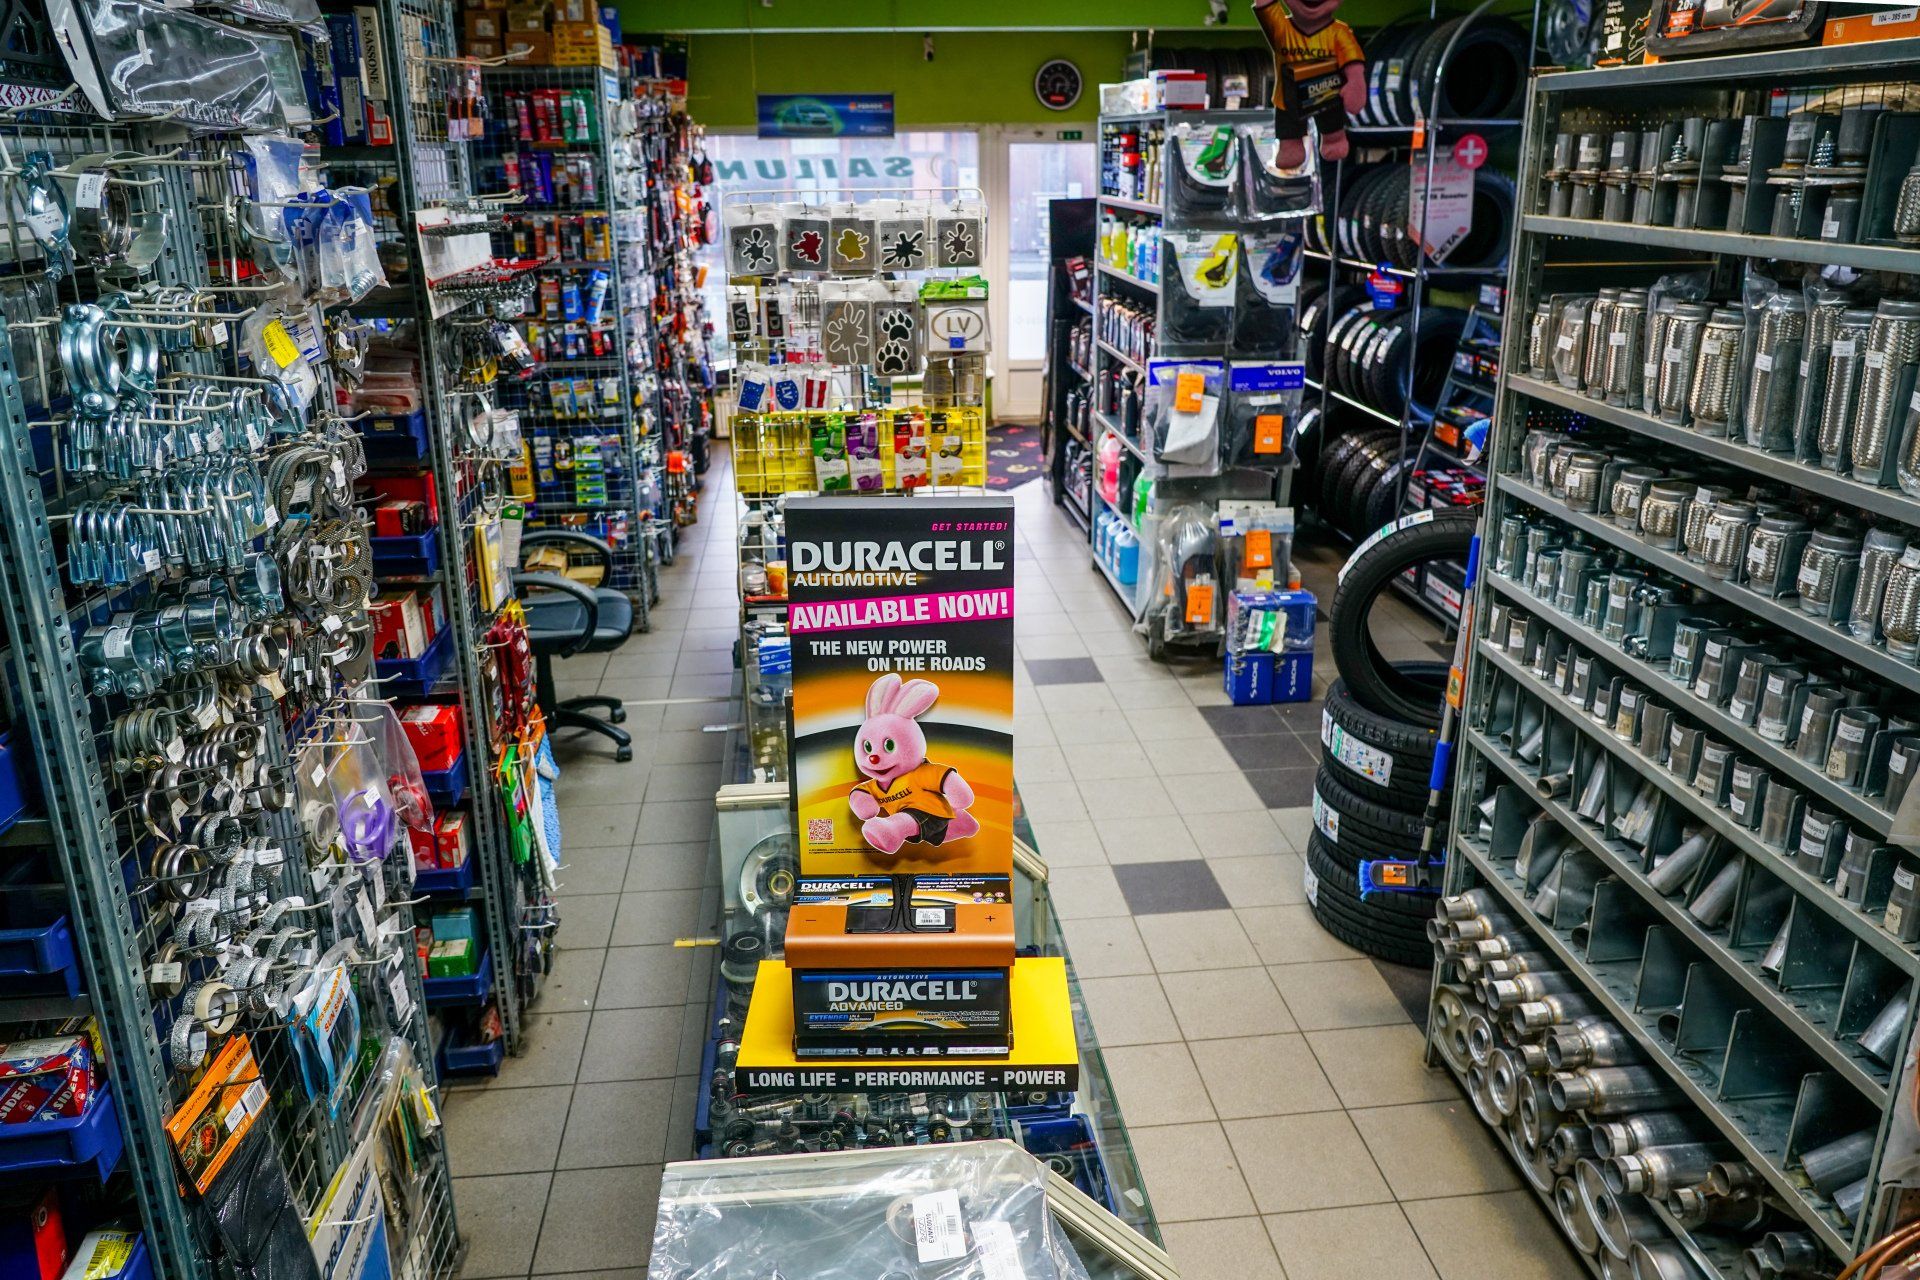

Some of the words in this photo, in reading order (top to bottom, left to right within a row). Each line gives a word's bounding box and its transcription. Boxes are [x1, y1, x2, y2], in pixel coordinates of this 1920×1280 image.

[346, 34, 355, 63] SACHS
[364, 29, 380, 84] SASSONE
[734, 305, 748, 329] V6
[947, 316, 971, 333] LV
[1267, 368, 1301, 376] VOLVO
[781, 386, 794, 400] LV
[931, 523, 951, 531] GET
[956, 522, 1008, 531] STARTED!
[793, 573, 917, 587] AUTOMOTIVE
[792, 598, 930, 630] AVAILABLE
[938, 592, 1008, 618] NOW!
[810, 641, 841, 656] THE
[847, 640, 884, 655] NEW
[888, 640, 947, 655] POWER
[867, 657, 890, 671] ON
[893, 657, 925, 671] THE
[930, 657, 986, 671] ROADS
[878, 787, 912, 804] DURACELL
[801, 882, 874, 890] DURACELL
[829, 1001, 904, 1012] ADVANCED
[324, 1010, 336, 1032] SUN
[749, 1073, 795, 1087] LONG
[800, 1072, 837, 1087] LIFE
[855, 1071, 985, 1086] PERFORMANCE
[1004, 1070, 1066, 1085] POWER
[53, 1069, 81, 1110] SIDEM
[0, 1081, 32, 1119] SIDEM
[925, 1213, 935, 1244] EVMK0010
